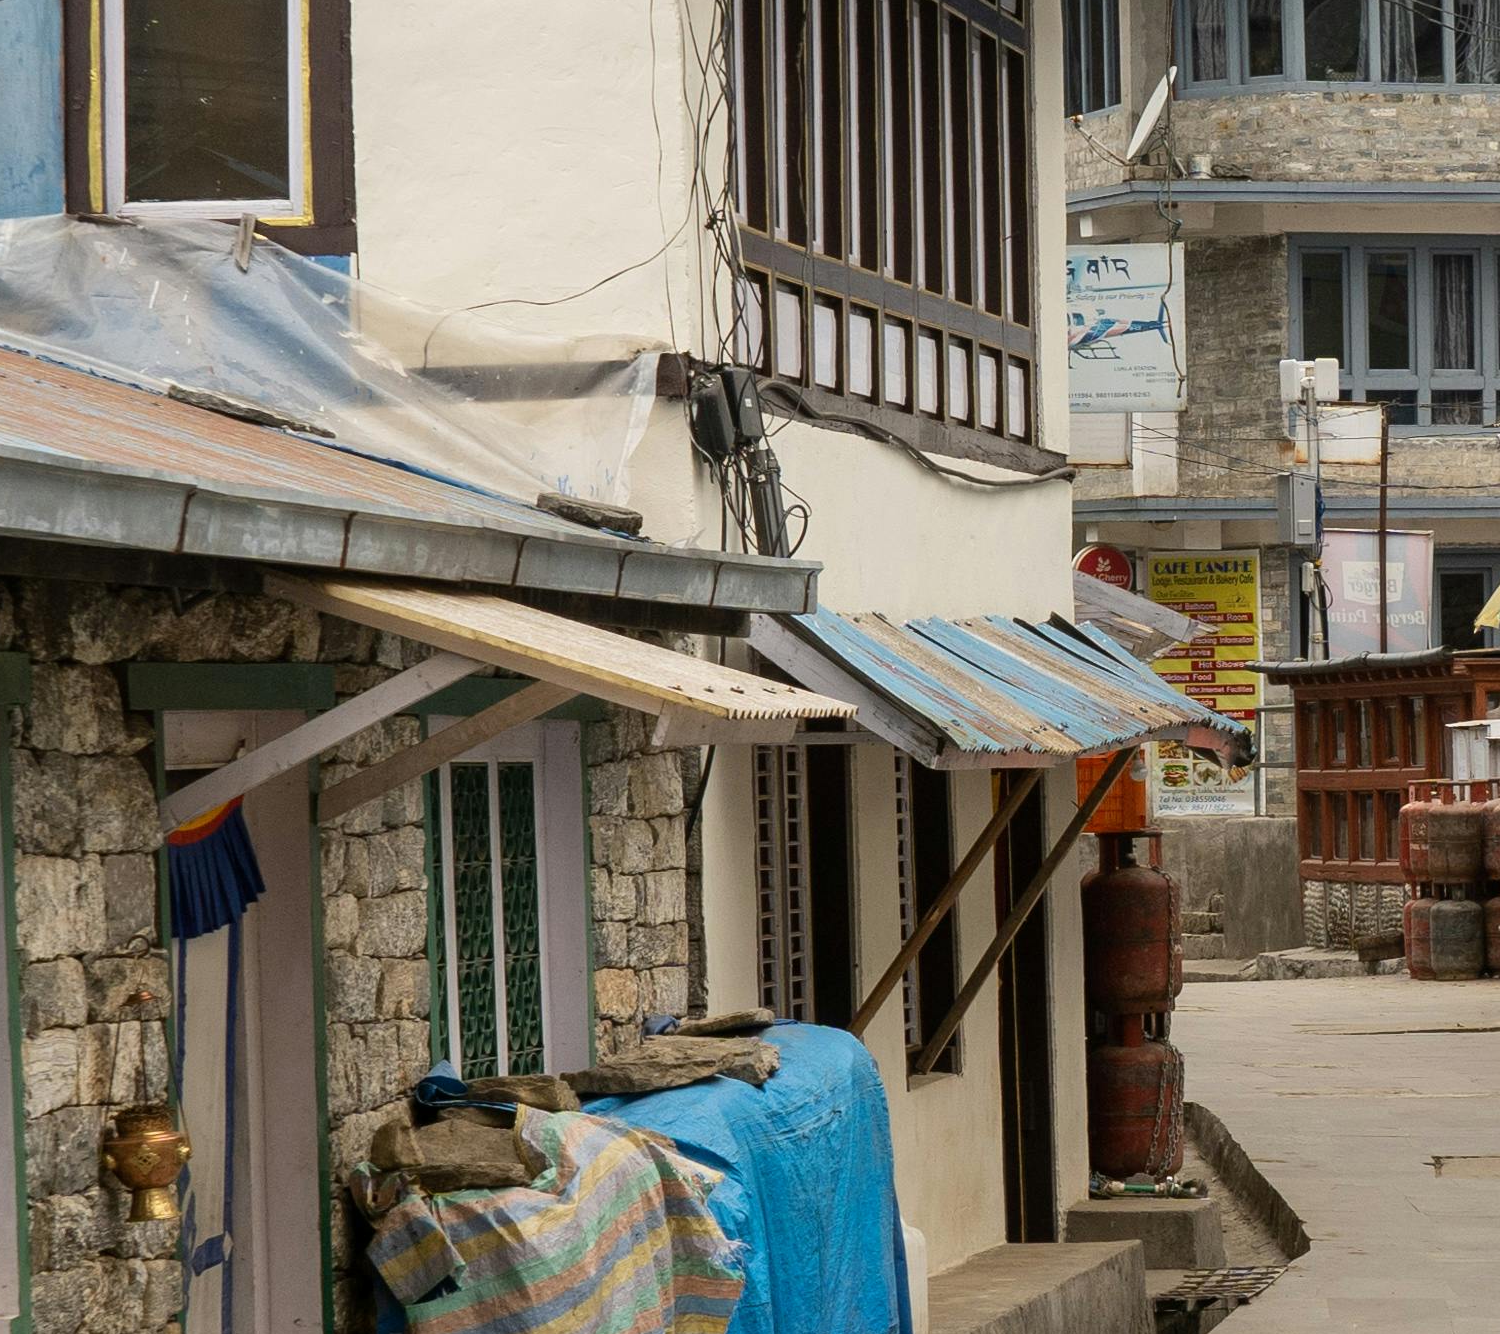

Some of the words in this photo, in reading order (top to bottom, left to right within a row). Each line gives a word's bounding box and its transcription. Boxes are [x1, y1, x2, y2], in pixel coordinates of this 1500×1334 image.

[1154, 561, 1188, 574] CAFE
[1174, 576, 1208, 585] Restaurant
[1209, 576, 1215, 584] &
[1216, 575, 1238, 586] Bakery
[1239, 574, 1254, 584] Cafe
[1226, 613, 1248, 621] Room
[1199, 661, 1213, 669] Hot
